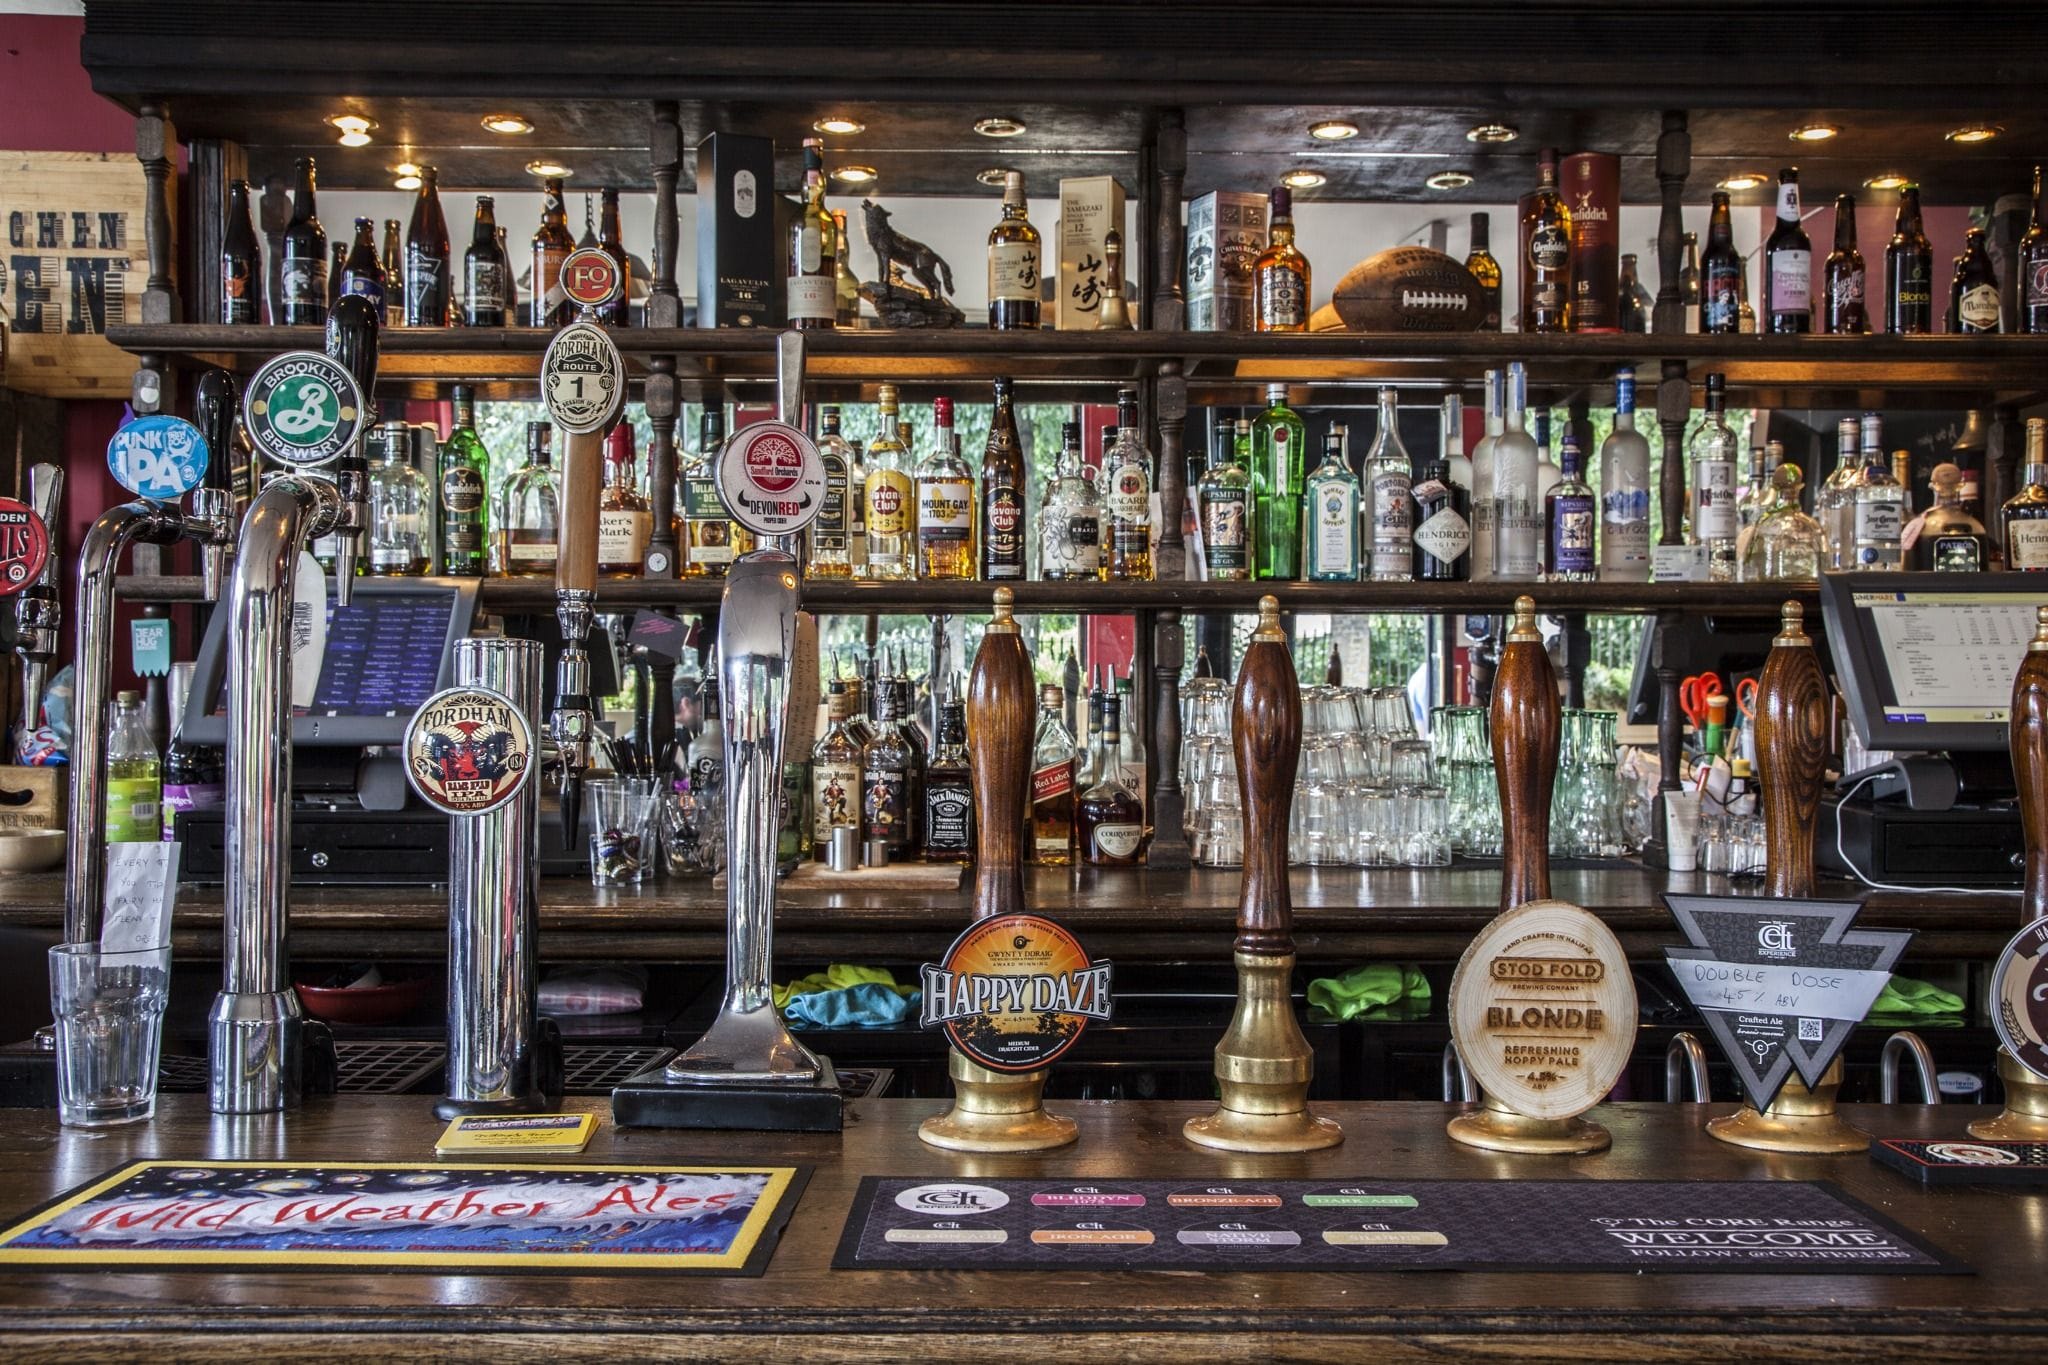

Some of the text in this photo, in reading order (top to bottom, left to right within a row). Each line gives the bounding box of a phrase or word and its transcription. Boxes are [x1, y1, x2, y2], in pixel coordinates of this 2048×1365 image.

[1066, 205, 1103, 213] YAMAZAKI
[1074, 223, 1084, 232] 12
[1220, 245, 1243, 254] CHIVAS
[1533, 241, 1567, 253] Glenfiddich
[719, 276, 769, 287] LAGAVULIN
[1577, 281, 1589, 291] 15
[738, 292, 752, 300] 16
[803, 292, 817, 300] 16
[555, 340, 609, 369] FORDHAM
[562, 362, 597, 371] ROUTE
[263, 362, 347, 394] BROOKLYN
[570, 376, 583, 398] 1
[115, 429, 164, 451] PUNK
[260, 428, 344, 459] BREWERY
[115, 450, 187, 493] IPA
[750, 466, 799, 477] Sandford Orchards
[444, 481, 482, 494] Glenfiddich
[1322, 487, 1346, 497] BOMBAY
[870, 489, 904, 500] Havana
[1203, 490, 1243, 499] SIPSMITH
[874, 499, 897, 511] Club
[921, 499, 969, 510] MOUNT GAY
[928, 509, 946, 519] 1703
[987, 506, 1021, 516] Havana
[600, 517, 633, 526] ker's
[993, 515, 1014, 526] Club
[1322, 519, 1346, 528] SAPPHIRE
[459, 524, 468, 532] 12
[600, 528, 633, 536] Mark
[1002, 535, 1007, 544] 7
[135, 636, 157, 648] HUG
[423, 707, 512, 732] FORDHAM
[834, 770, 856, 781] Morgan
[878, 770, 902, 781] Morgan
[1034, 770, 1071, 790] Red Label
[450, 790, 488, 798] IPA
[929, 792, 946, 807] JACK
[935, 815, 963, 823] Tennessee
[115, 858, 149, 867] EVERY
[986, 926, 1001, 935] FROM
[1029, 922, 1053, 934] PRESSED
[1053, 931, 1069, 945] FRUIT
[1502, 933, 1594, 955] HAND CRAFTED IN HALIFAX
[1758, 950, 1797, 958] EXPERIENCE
[1497, 962, 1597, 978] STOD FOLD
[1694, 963, 1844, 989] DOUBLE DOSE
[926, 966, 1112, 1024] HAPPY DAZE
[1774, 994, 1800, 1008] ABV
[1487, 1006, 1603, 1031] BLONDE
[1738, 1015, 1784, 1026] Crafted Ale
[1504, 1045, 1580, 1056] REFRESHING
[1504, 1055, 1579, 1067] HOPPY PALE
[1531, 1082, 1548, 1090] ABV
[76, 1184, 737, 1233] Wild Weather Ales
[1629, 1217, 1768, 1227] The CORE
[1050, 1233, 1137, 1241] IRON AGE
[1608, 1232, 1889, 1247] WELCOME
